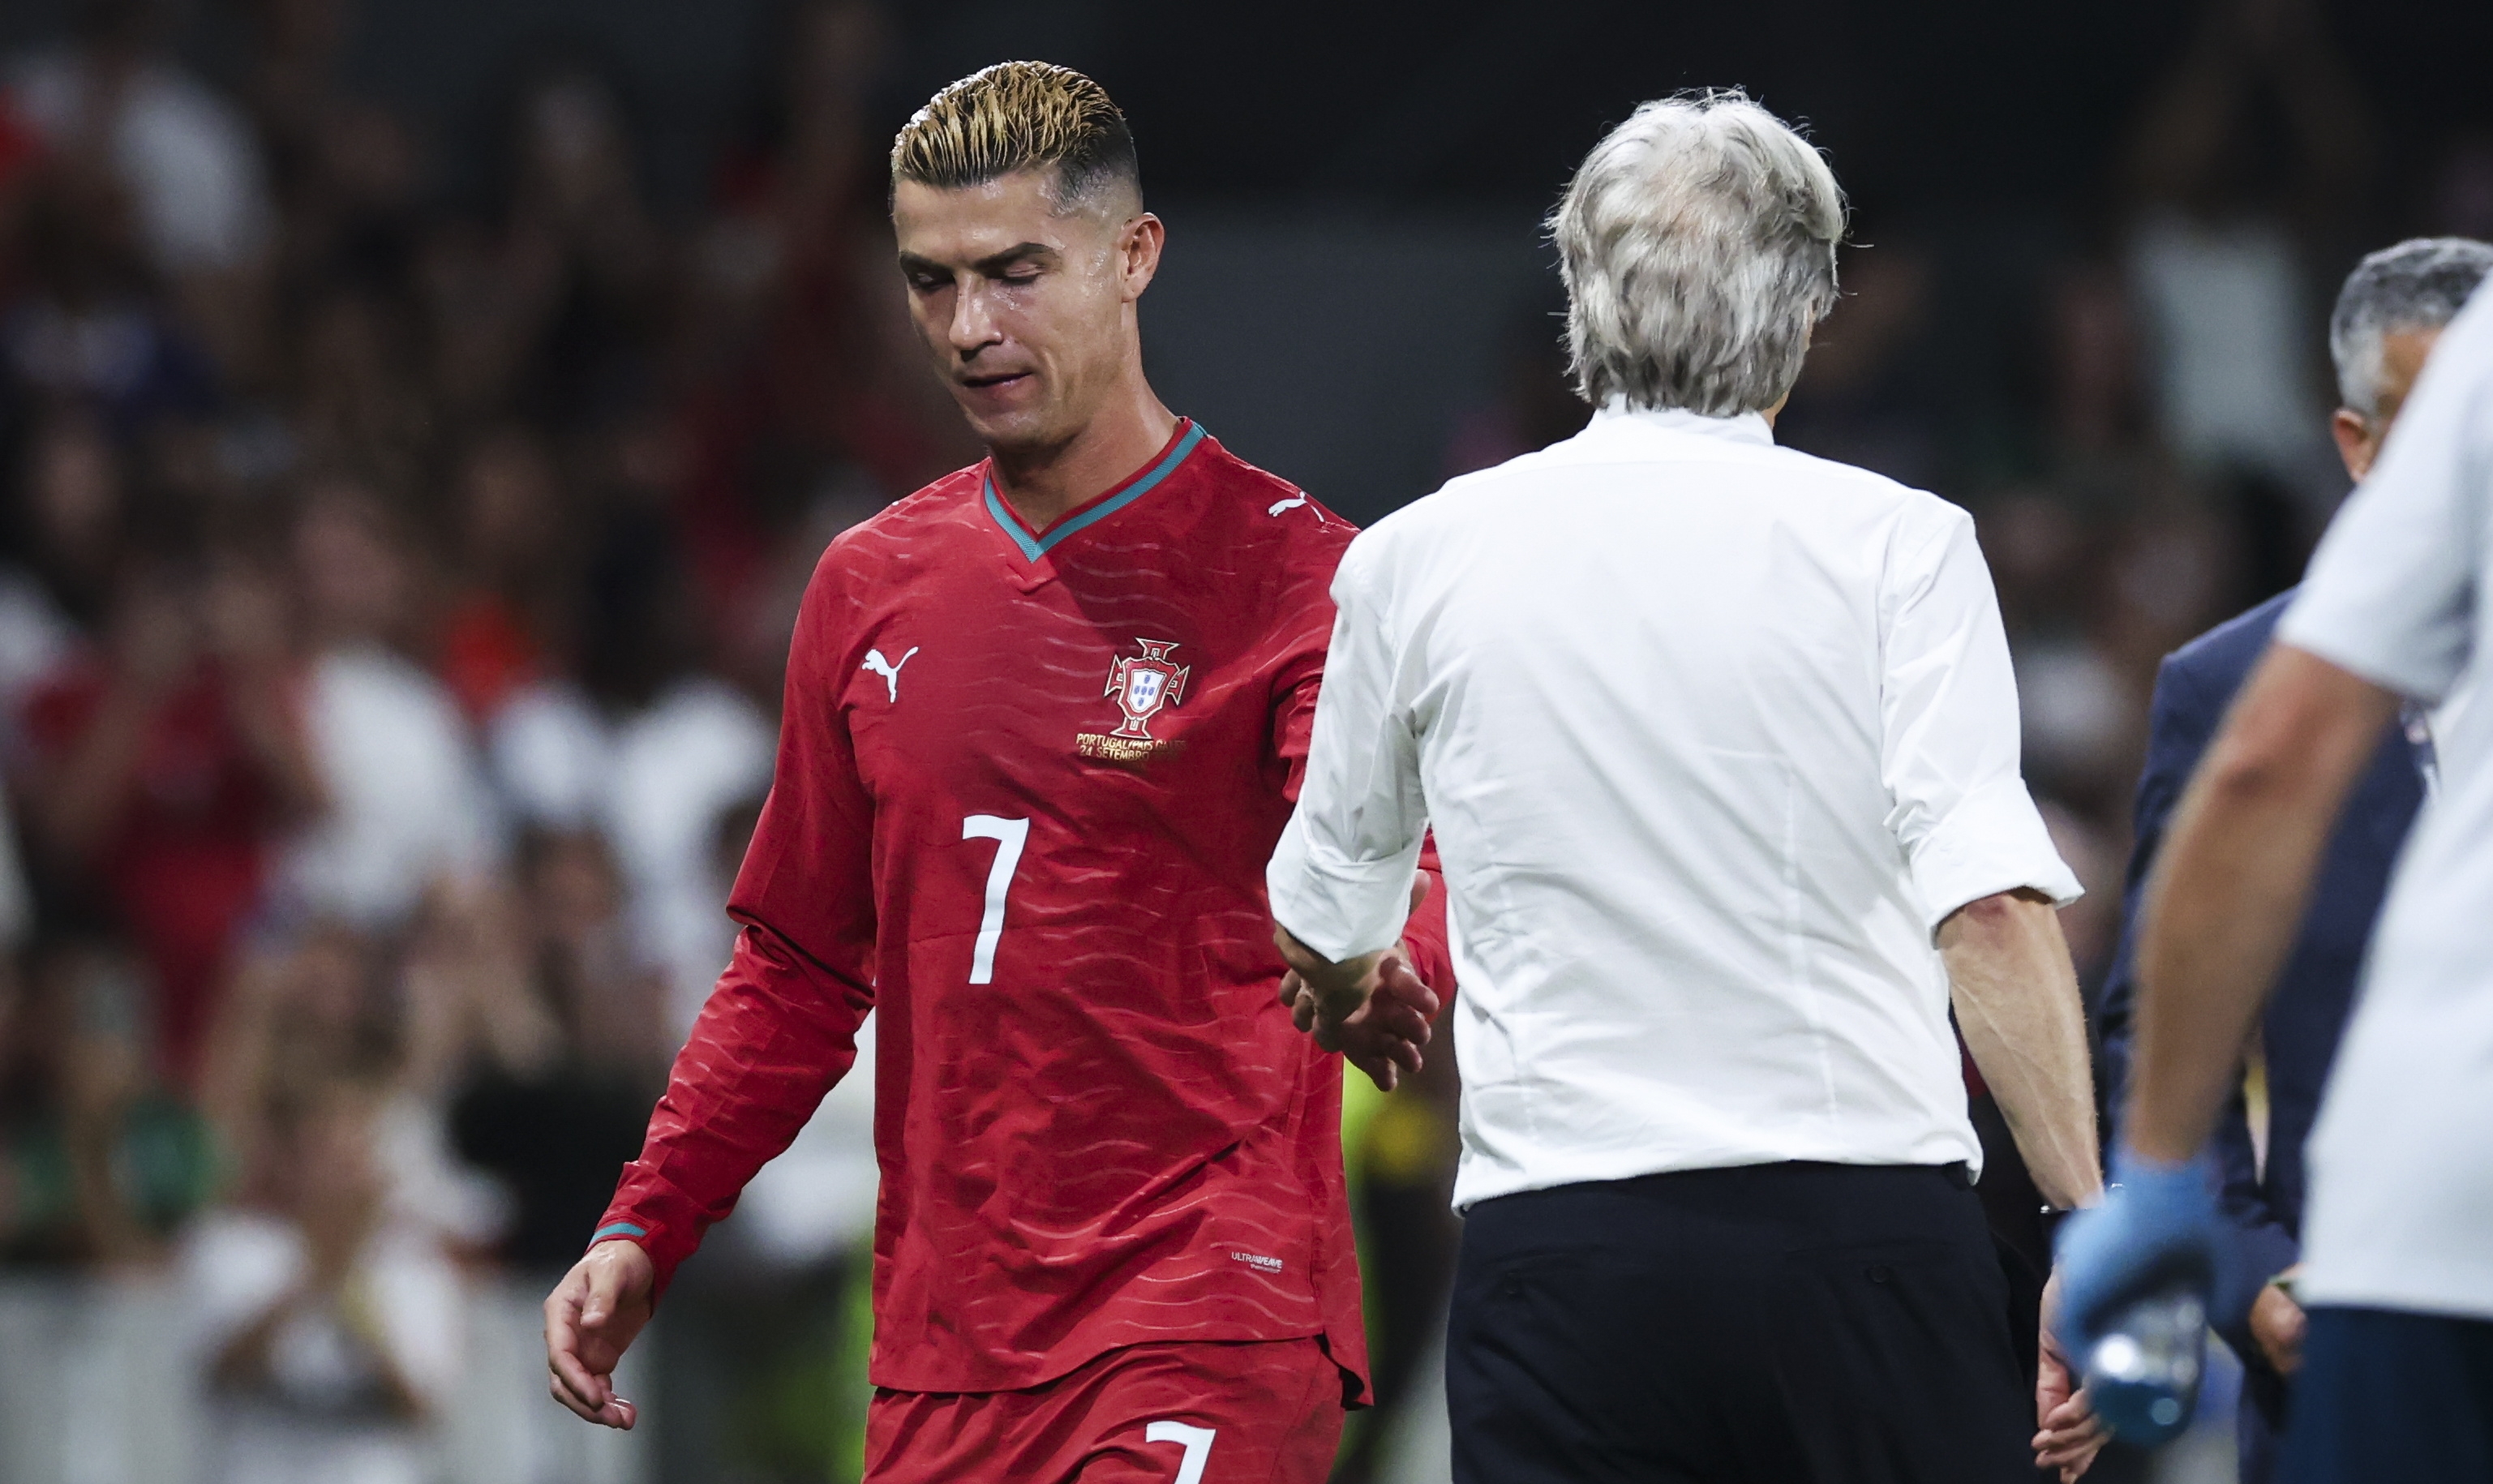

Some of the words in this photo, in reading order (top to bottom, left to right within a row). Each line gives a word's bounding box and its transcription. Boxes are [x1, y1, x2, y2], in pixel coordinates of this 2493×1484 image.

[1079, 744, 1092, 757] 24
[1096, 746, 1150, 761] SETEMBRO
[963, 814, 1029, 984] 7
[1231, 1251, 1283, 1269] ULTRAWEAVE
[1146, 1421, 1216, 1484] 7
